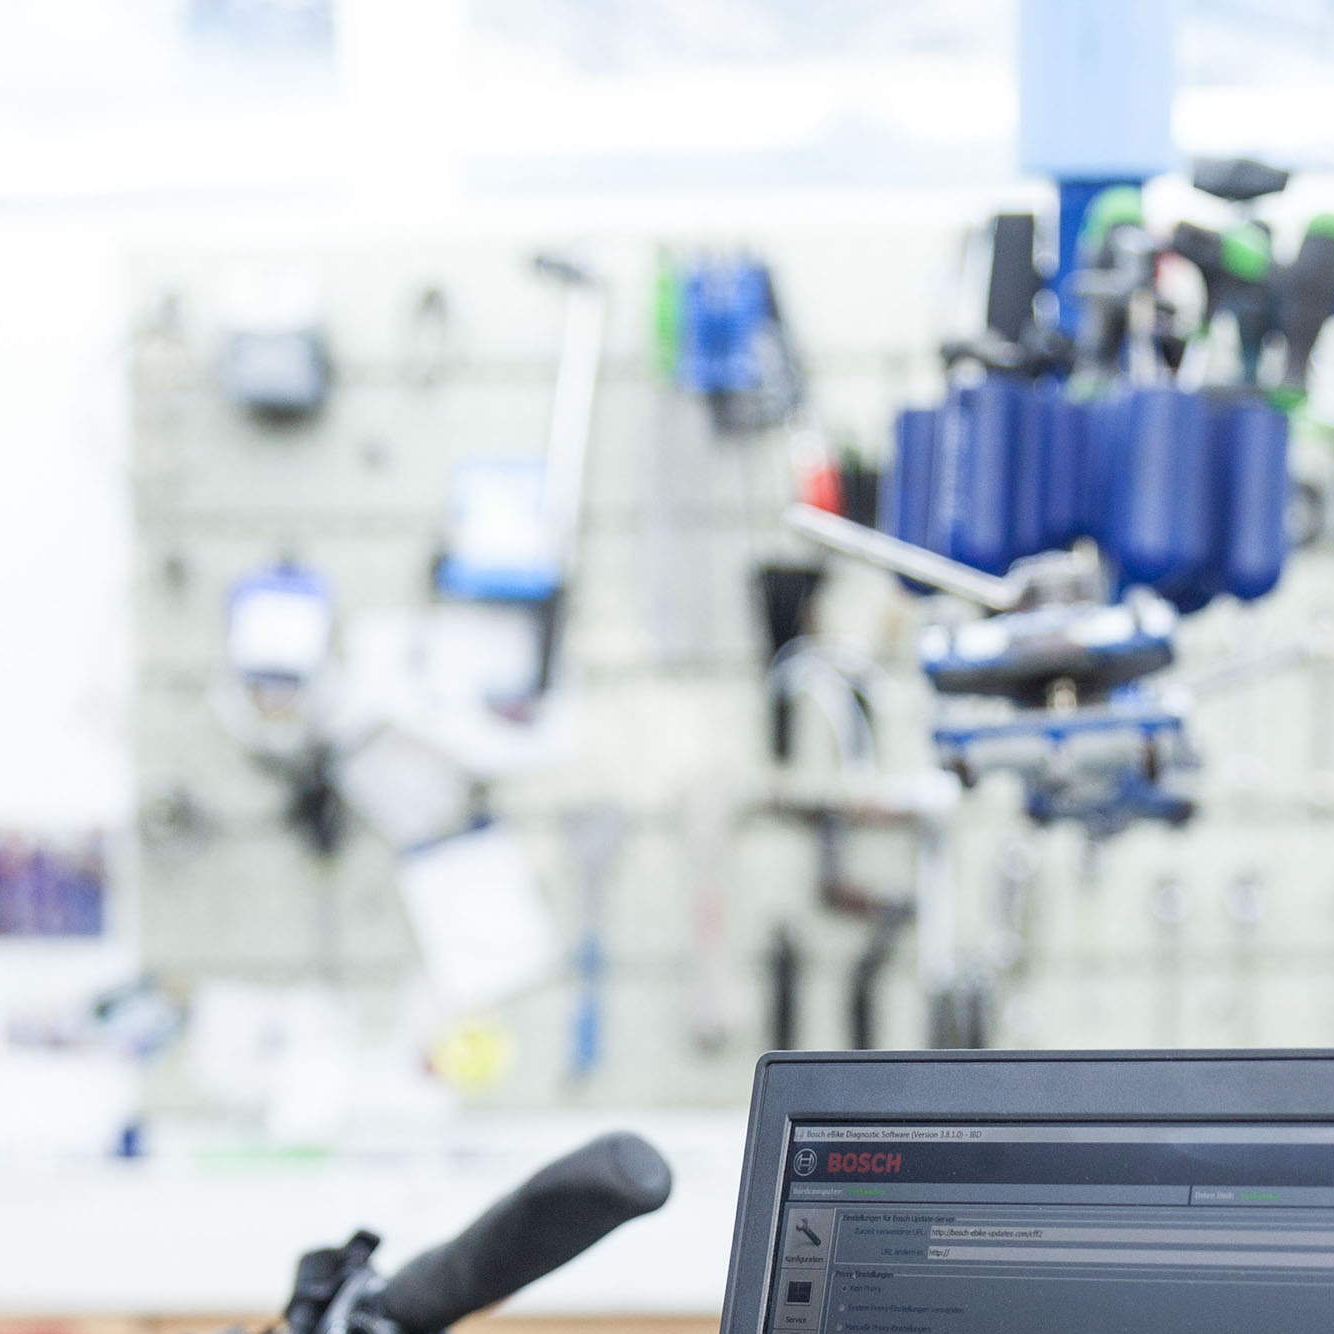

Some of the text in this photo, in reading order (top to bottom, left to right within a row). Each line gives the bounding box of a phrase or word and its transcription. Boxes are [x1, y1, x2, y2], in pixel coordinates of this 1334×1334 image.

[806, 1130, 826, 1138] Bosch
[826, 1130, 845, 1138] eBike
[846, 1130, 880, 1140] Diagnostic
[881, 1130, 910, 1139] Software
[911, 1130, 939, 1140] (Version
[827, 1152, 902, 1173] BOSCH
[842, 1214, 881, 1223] Einstellungen
[928, 1248, 950, 1258] http://
[785, 1255, 824, 1264] Konfiguration
